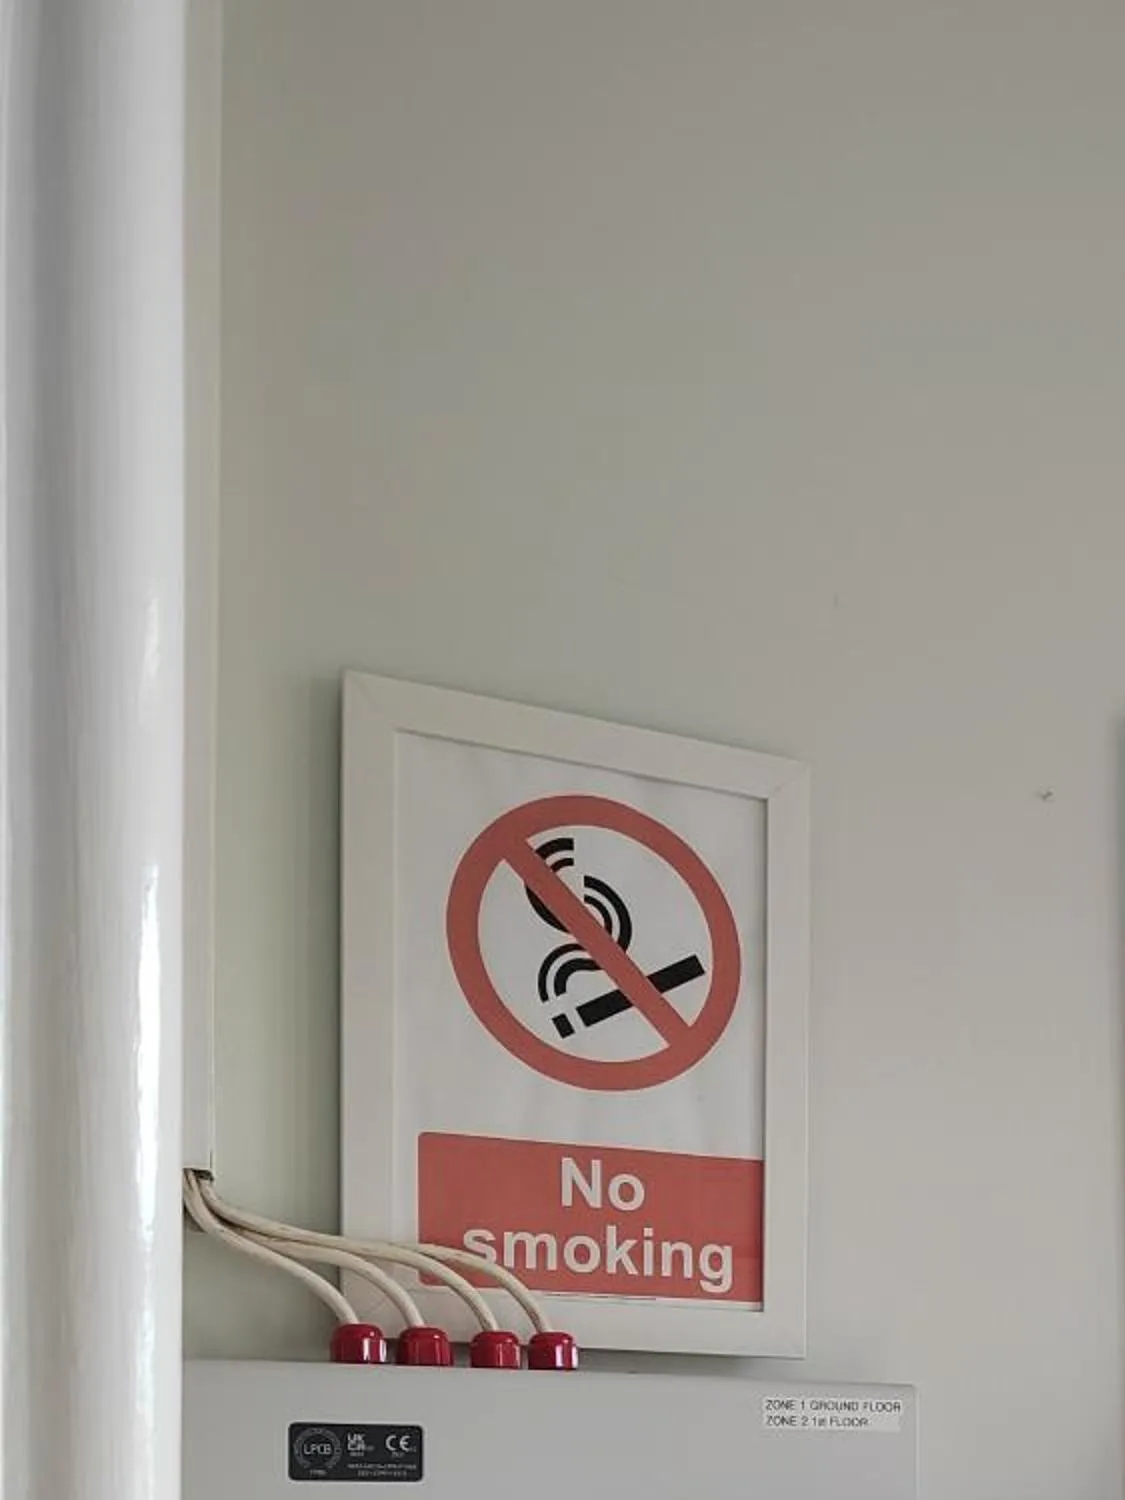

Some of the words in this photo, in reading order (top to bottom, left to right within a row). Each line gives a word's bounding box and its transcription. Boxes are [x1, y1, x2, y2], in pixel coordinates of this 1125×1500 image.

[560, 1156, 646, 1212] No
[462, 1224, 734, 1294] smoking
[765, 1399, 797, 1411] ZONE
[800, 1400, 806, 1411] 1
[809, 1401, 860, 1412] GROUND
[863, 1402, 902, 1413] FLOOR
[766, 1415, 797, 1427] ZONE
[801, 1416, 809, 1427] 2
[829, 1417, 869, 1428] FLOOR
